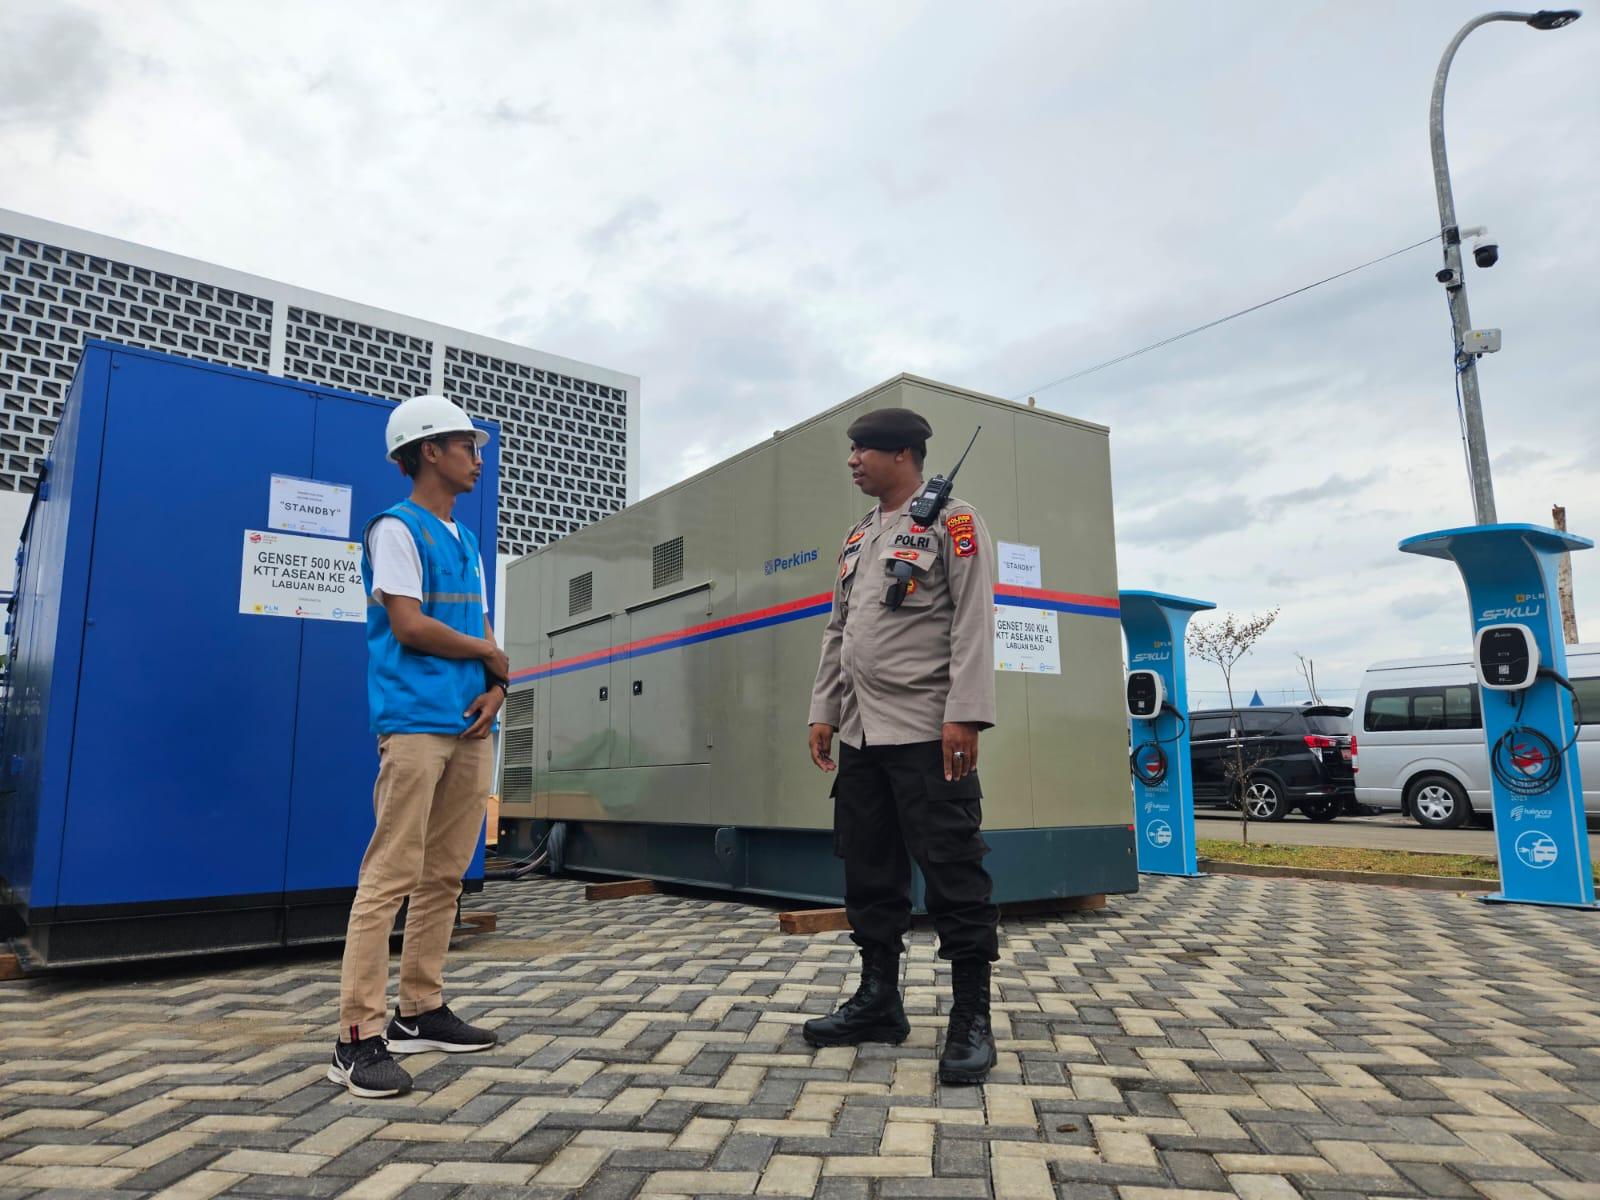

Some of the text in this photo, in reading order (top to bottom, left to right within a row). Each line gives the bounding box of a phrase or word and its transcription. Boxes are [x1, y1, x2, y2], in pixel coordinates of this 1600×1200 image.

[894, 534, 930, 548] POLRI
[258, 551, 357, 572] GENSET 500 KVA
[774, 549, 818, 572] Perkins
[253, 565, 362, 585] KTT ASEAN KE 42
[272, 579, 345, 594] LABUAN BAJO
[1477, 604, 1540, 622] SPKLU
[997, 619, 1049, 633] GENSET 500 KVA
[996, 631, 1053, 644] KTT ASEAN KE 42
[1006, 641, 1045, 651] LABUAN BAJO
